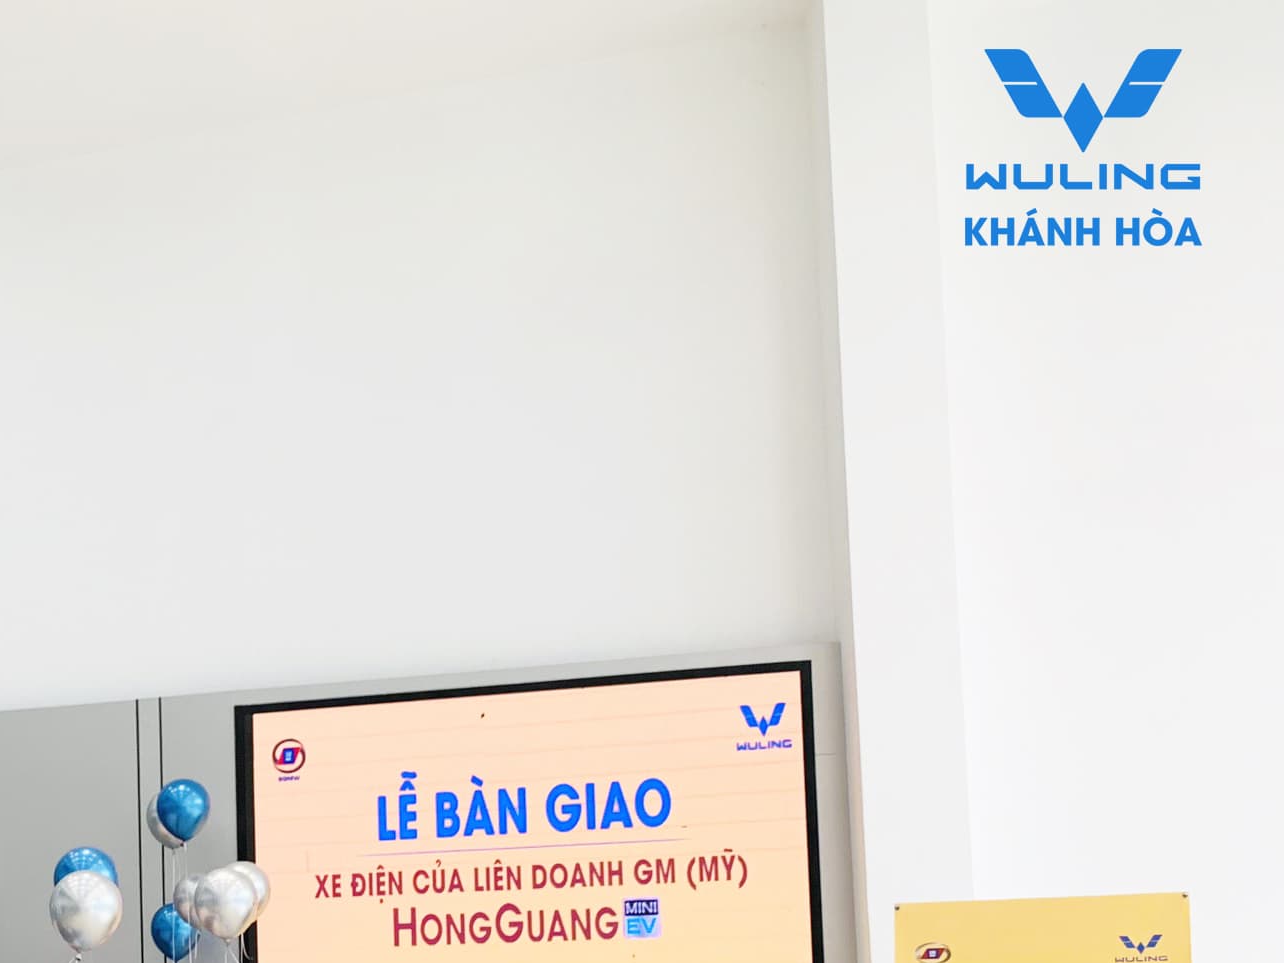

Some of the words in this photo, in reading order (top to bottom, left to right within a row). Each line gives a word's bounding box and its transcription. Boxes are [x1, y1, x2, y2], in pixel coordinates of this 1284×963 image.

[736, 739, 793, 752] WULING
[377, 771, 417, 841] LỄ
[436, 776, 526, 838] BÀN
[546, 778, 672, 831] GIAO
[315, 873, 343, 898] XE
[350, 865, 403, 903] ĐIỆN
[413, 859, 463, 893] CỦA
[473, 859, 520, 891] LIÊN
[531, 860, 624, 889] DOANH
[633, 858, 676, 884] GM
[687, 848, 748, 891] (MỸ)
[624, 900, 659, 914] MINI
[625, 917, 657, 936] EV
[1115, 955, 1169, 963] WULING
